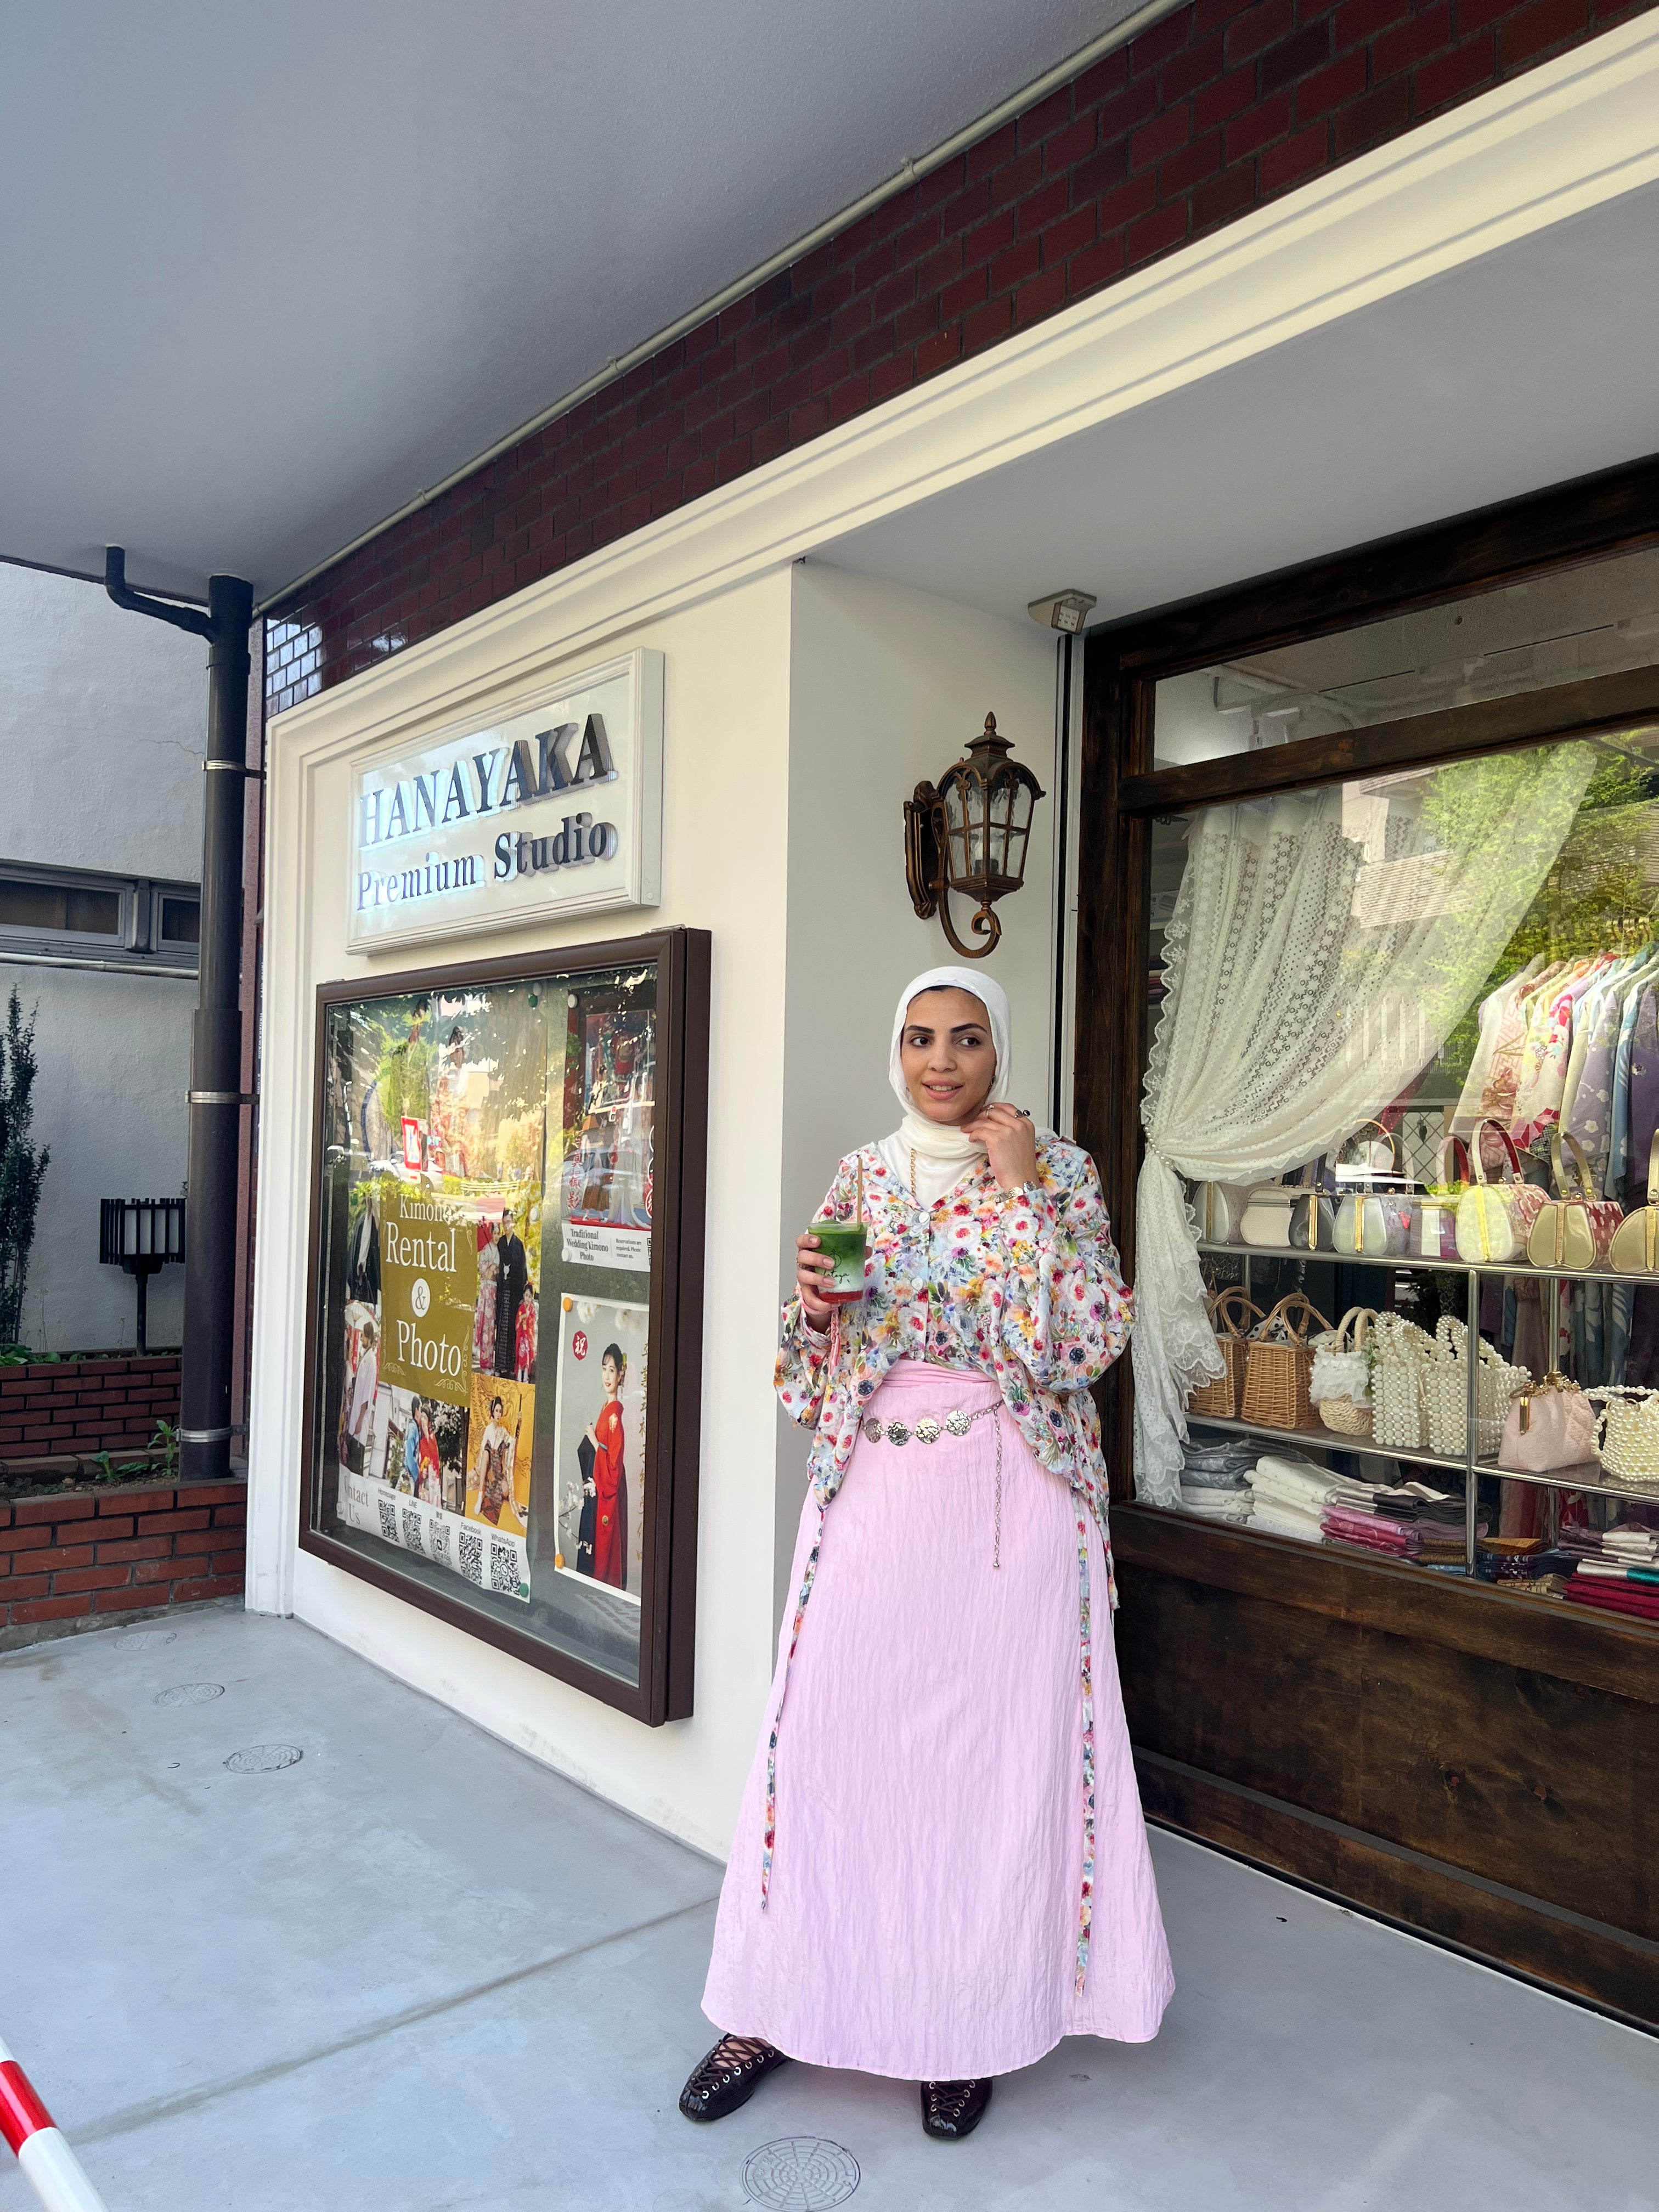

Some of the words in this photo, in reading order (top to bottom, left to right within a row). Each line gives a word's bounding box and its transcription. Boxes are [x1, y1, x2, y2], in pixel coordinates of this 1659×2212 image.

[358, 713, 618, 851] HANAYAKA
[358, 853, 484, 913] Premium
[495, 812, 618, 881] Studio
[399, 1193, 452, 1223] Kimono
[567, 1238, 588, 1251] Wedding
[571, 1228, 599, 1240] Traditional
[386, 1221, 457, 1273] Rental
[580, 1251, 594, 1261] Photo
[415, 1285, 426, 1311] &
[397, 1319, 461, 1377] Photo
[575, 1335, 586, 1356] 祝
[345, 1476, 369, 1507] Cntact
[348, 1503, 360, 1525] Us
[409, 1499, 417, 1509] LINE
[460, 1522, 482, 1536] Facebook
[491, 1533, 515, 1548] WhatsApp
